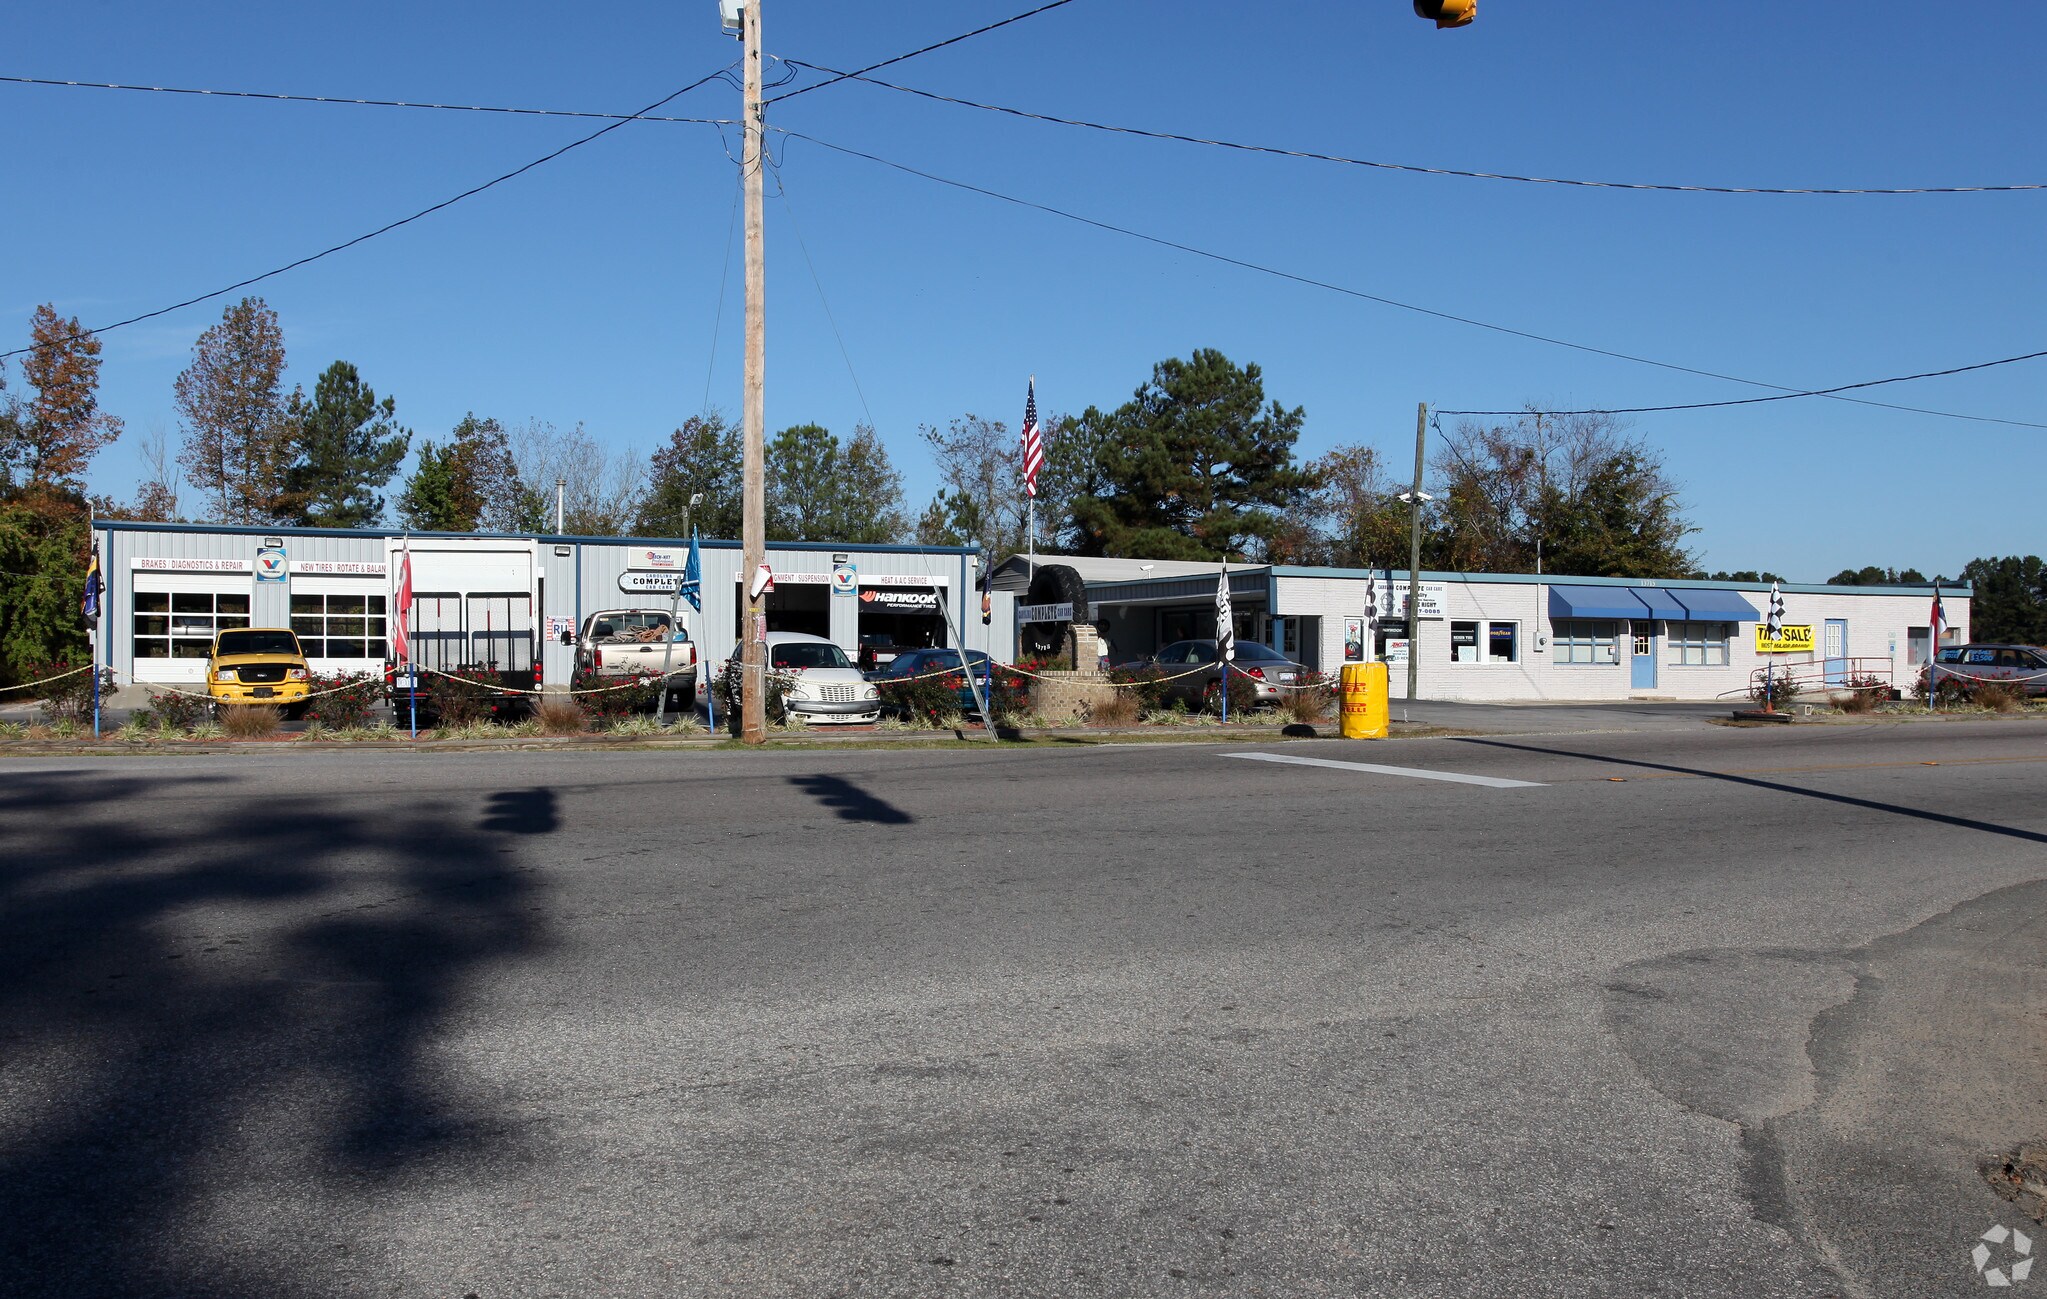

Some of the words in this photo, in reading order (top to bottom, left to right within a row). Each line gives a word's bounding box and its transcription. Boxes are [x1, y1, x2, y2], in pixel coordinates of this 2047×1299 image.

[141, 559, 167, 569] BRAKES
[171, 560, 214, 570] DIAGNOSTICS
[215, 561, 220, 570] &
[221, 561, 243, 570] REPAIR
[300, 563, 314, 572] NEW
[315, 563, 333, 572] TIRES
[336, 564, 359, 573] ROTATE
[360, 564, 365, 573] &
[366, 564, 386, 573] BALAN
[773, 573, 795, 582] IGNMENT
[798, 574, 830, 582] SUSPENSION
[908, 577, 927, 585] SERVICE
[1031, 605, 1057, 620] COMPLETE
